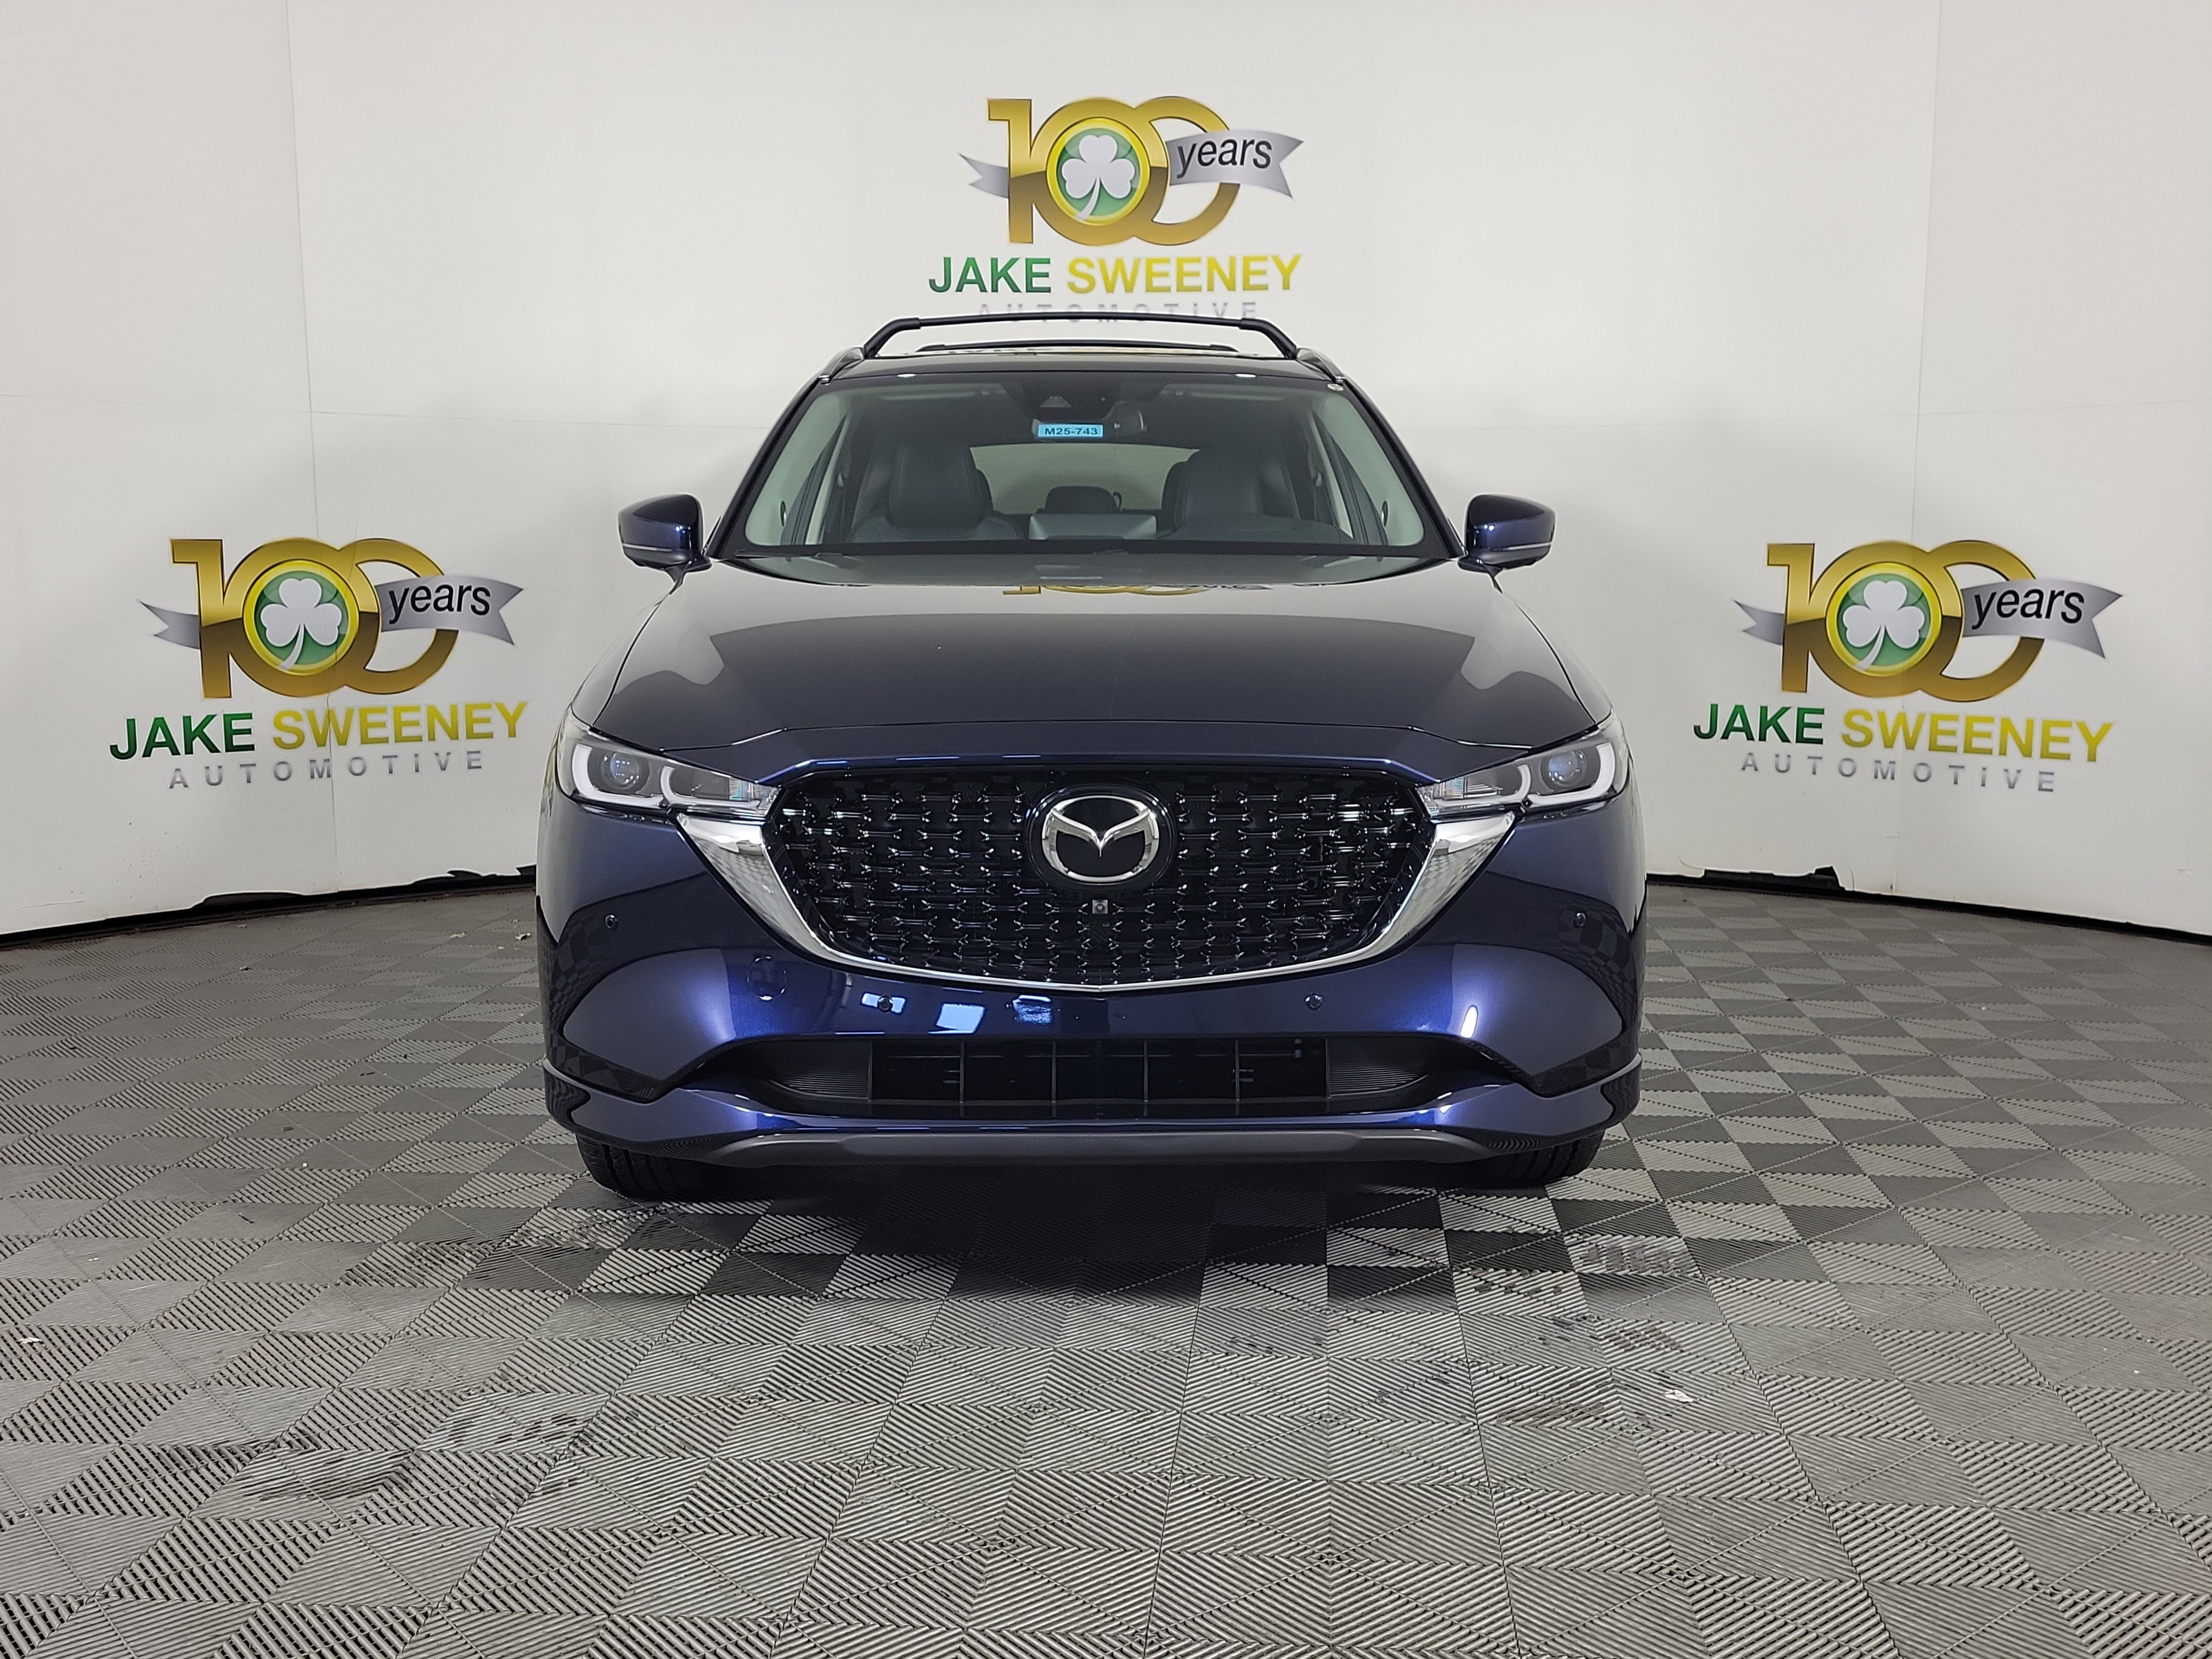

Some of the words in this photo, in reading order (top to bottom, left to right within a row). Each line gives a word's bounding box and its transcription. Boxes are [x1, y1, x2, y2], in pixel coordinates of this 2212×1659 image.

[988, 96, 1240, 245] 100
[1176, 138, 1272, 179] years
[928, 256, 1051, 294] JAKE
[1067, 253, 1302, 293] SWEENEY
[170, 537, 459, 699] 100
[388, 582, 490, 624] years
[1767, 540, 2045, 703] 100
[1971, 589, 2084, 630] years
[110, 712, 255, 760] JAKE
[272, 701, 528, 750] SWEENEY
[1693, 703, 1825, 746] JAKE
[1841, 708, 2113, 763] SWEENEY
[168, 750, 482, 789] AUTOMOTIVE
[1741, 752, 2055, 793] AUTOMOTIVE
